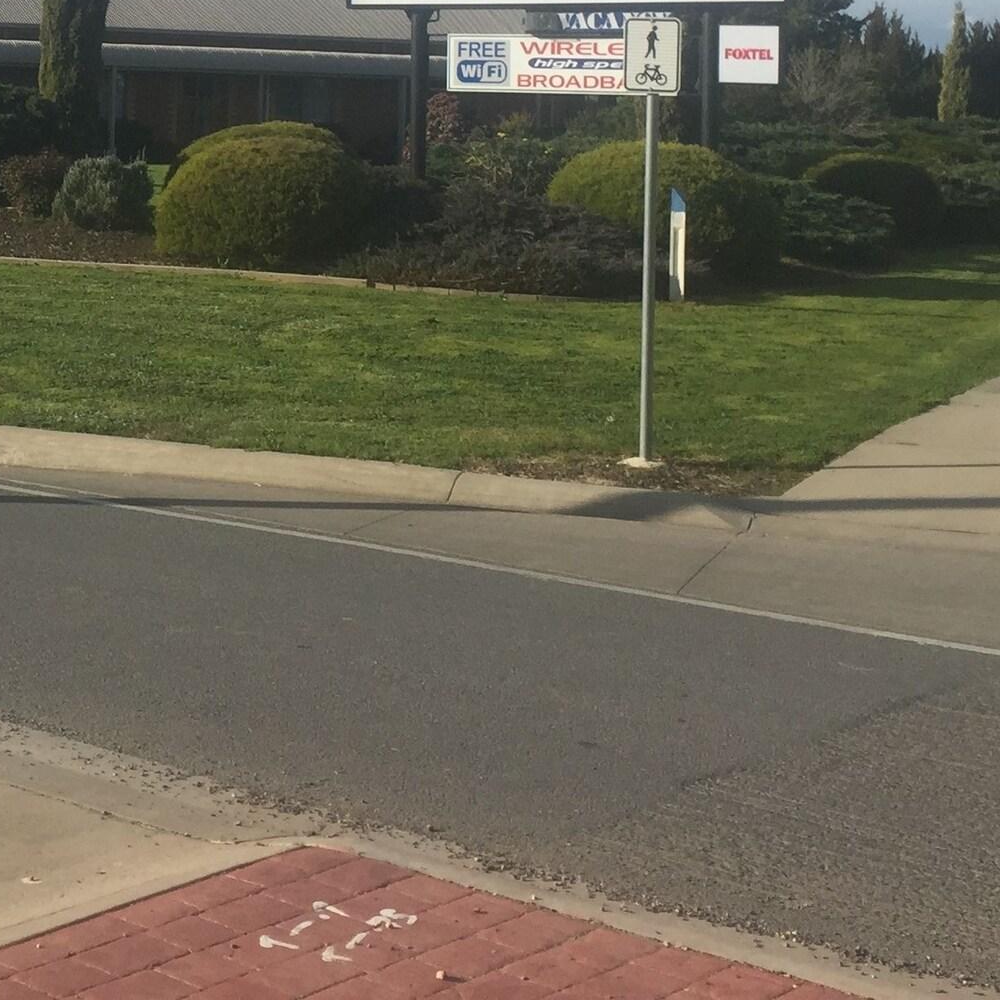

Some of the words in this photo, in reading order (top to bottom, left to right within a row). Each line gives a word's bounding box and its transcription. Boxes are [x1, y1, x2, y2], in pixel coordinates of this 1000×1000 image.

[457, 41, 506, 58] FREE
[724, 48, 774, 61] FOXTEL
[534, 59, 577, 69] high
